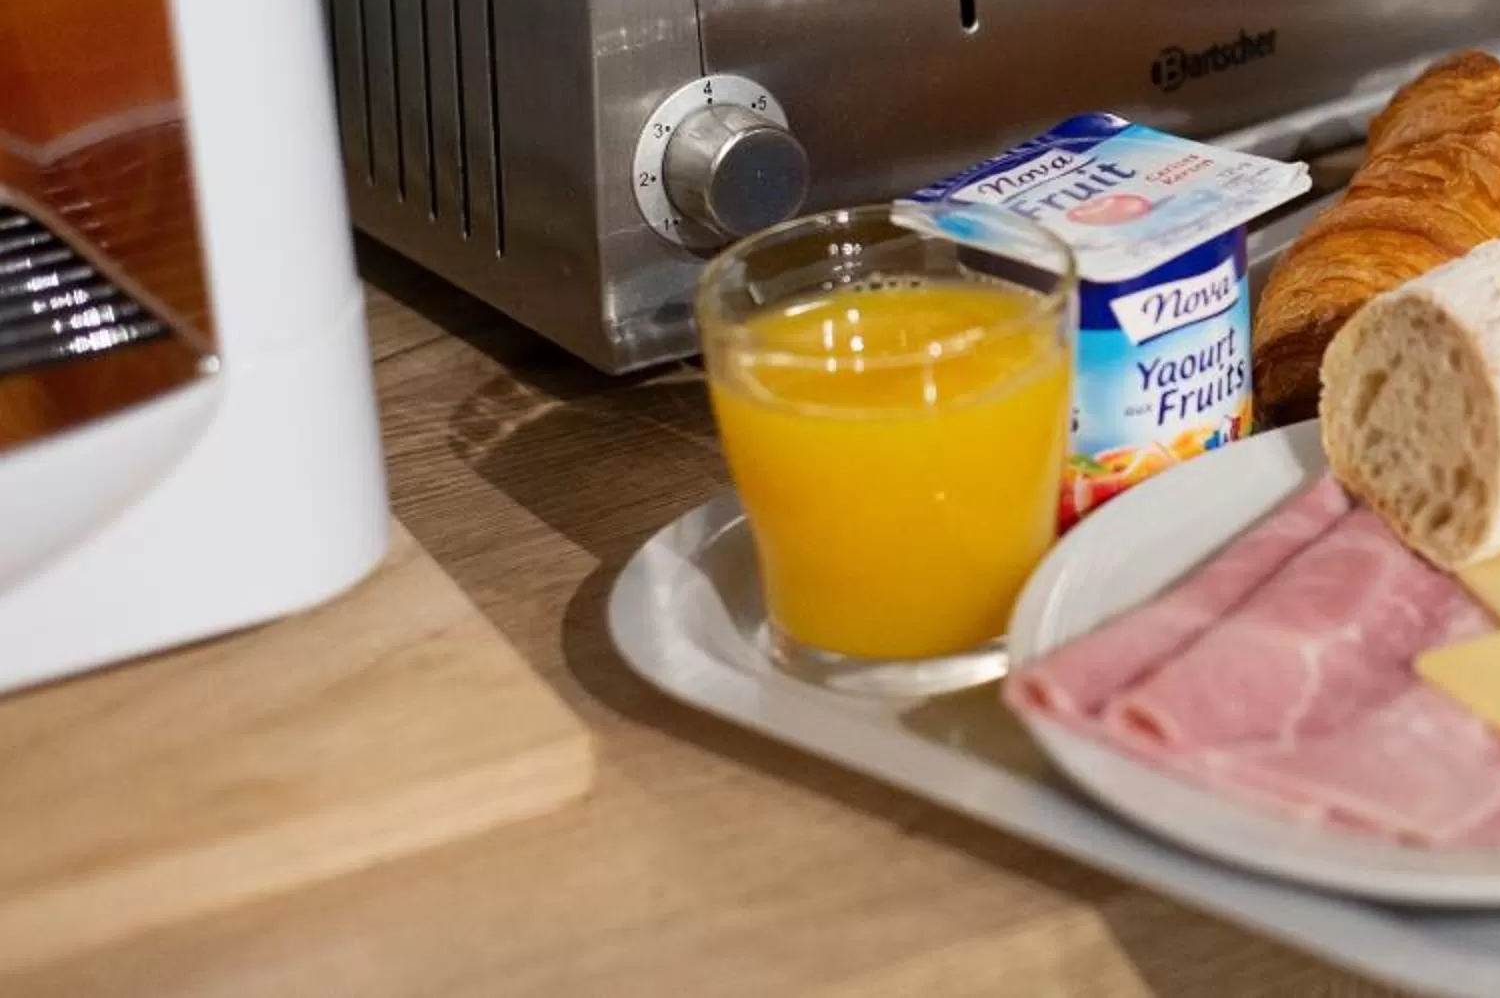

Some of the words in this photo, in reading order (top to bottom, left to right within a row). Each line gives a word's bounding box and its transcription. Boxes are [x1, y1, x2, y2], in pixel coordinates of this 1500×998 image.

[1151, 26, 1277, 94] Bartscher
[703, 79, 713, 95] 4
[758, 95, 768, 111] 5
[653, 123, 664, 139] 3
[639, 172, 650, 188] 2
[977, 154, 1074, 196] Nova
[1009, 160, 1137, 222] Fruit
[663, 218, 671, 231] 1
[1140, 275, 1231, 325] Nova
[1136, 325, 1236, 392] Yaourt
[1156, 358, 1247, 427] Fruits
